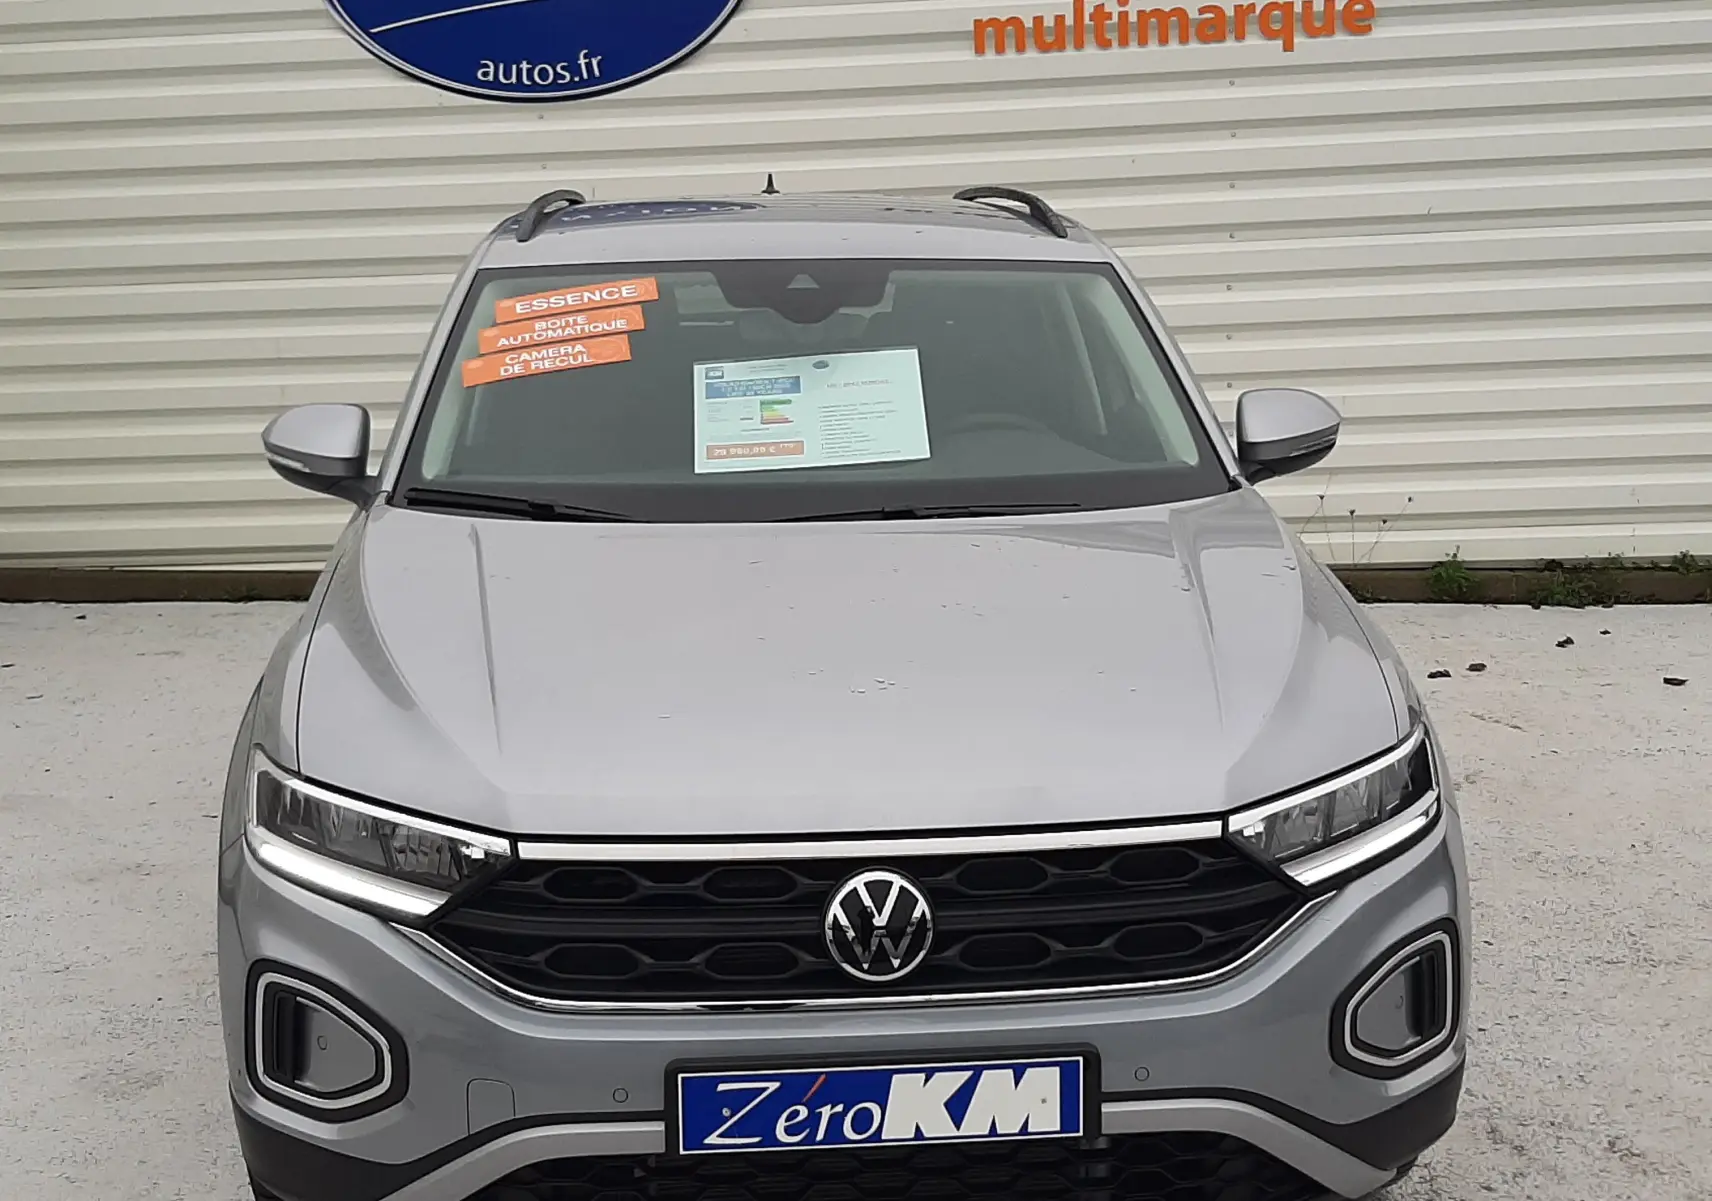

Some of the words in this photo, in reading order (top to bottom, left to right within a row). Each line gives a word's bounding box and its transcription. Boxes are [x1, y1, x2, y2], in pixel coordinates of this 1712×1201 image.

[973, 0, 1377, 54] multimarque
[476, 49, 602, 85] autos.fr
[515, 285, 639, 314] ESSENCE
[496, 318, 628, 348] AUTOMATIQUE
[535, 315, 589, 332] BOITE
[500, 364, 526, 377] DE
[531, 353, 594, 371] RECUL
[505, 343, 588, 365] CAMERA
